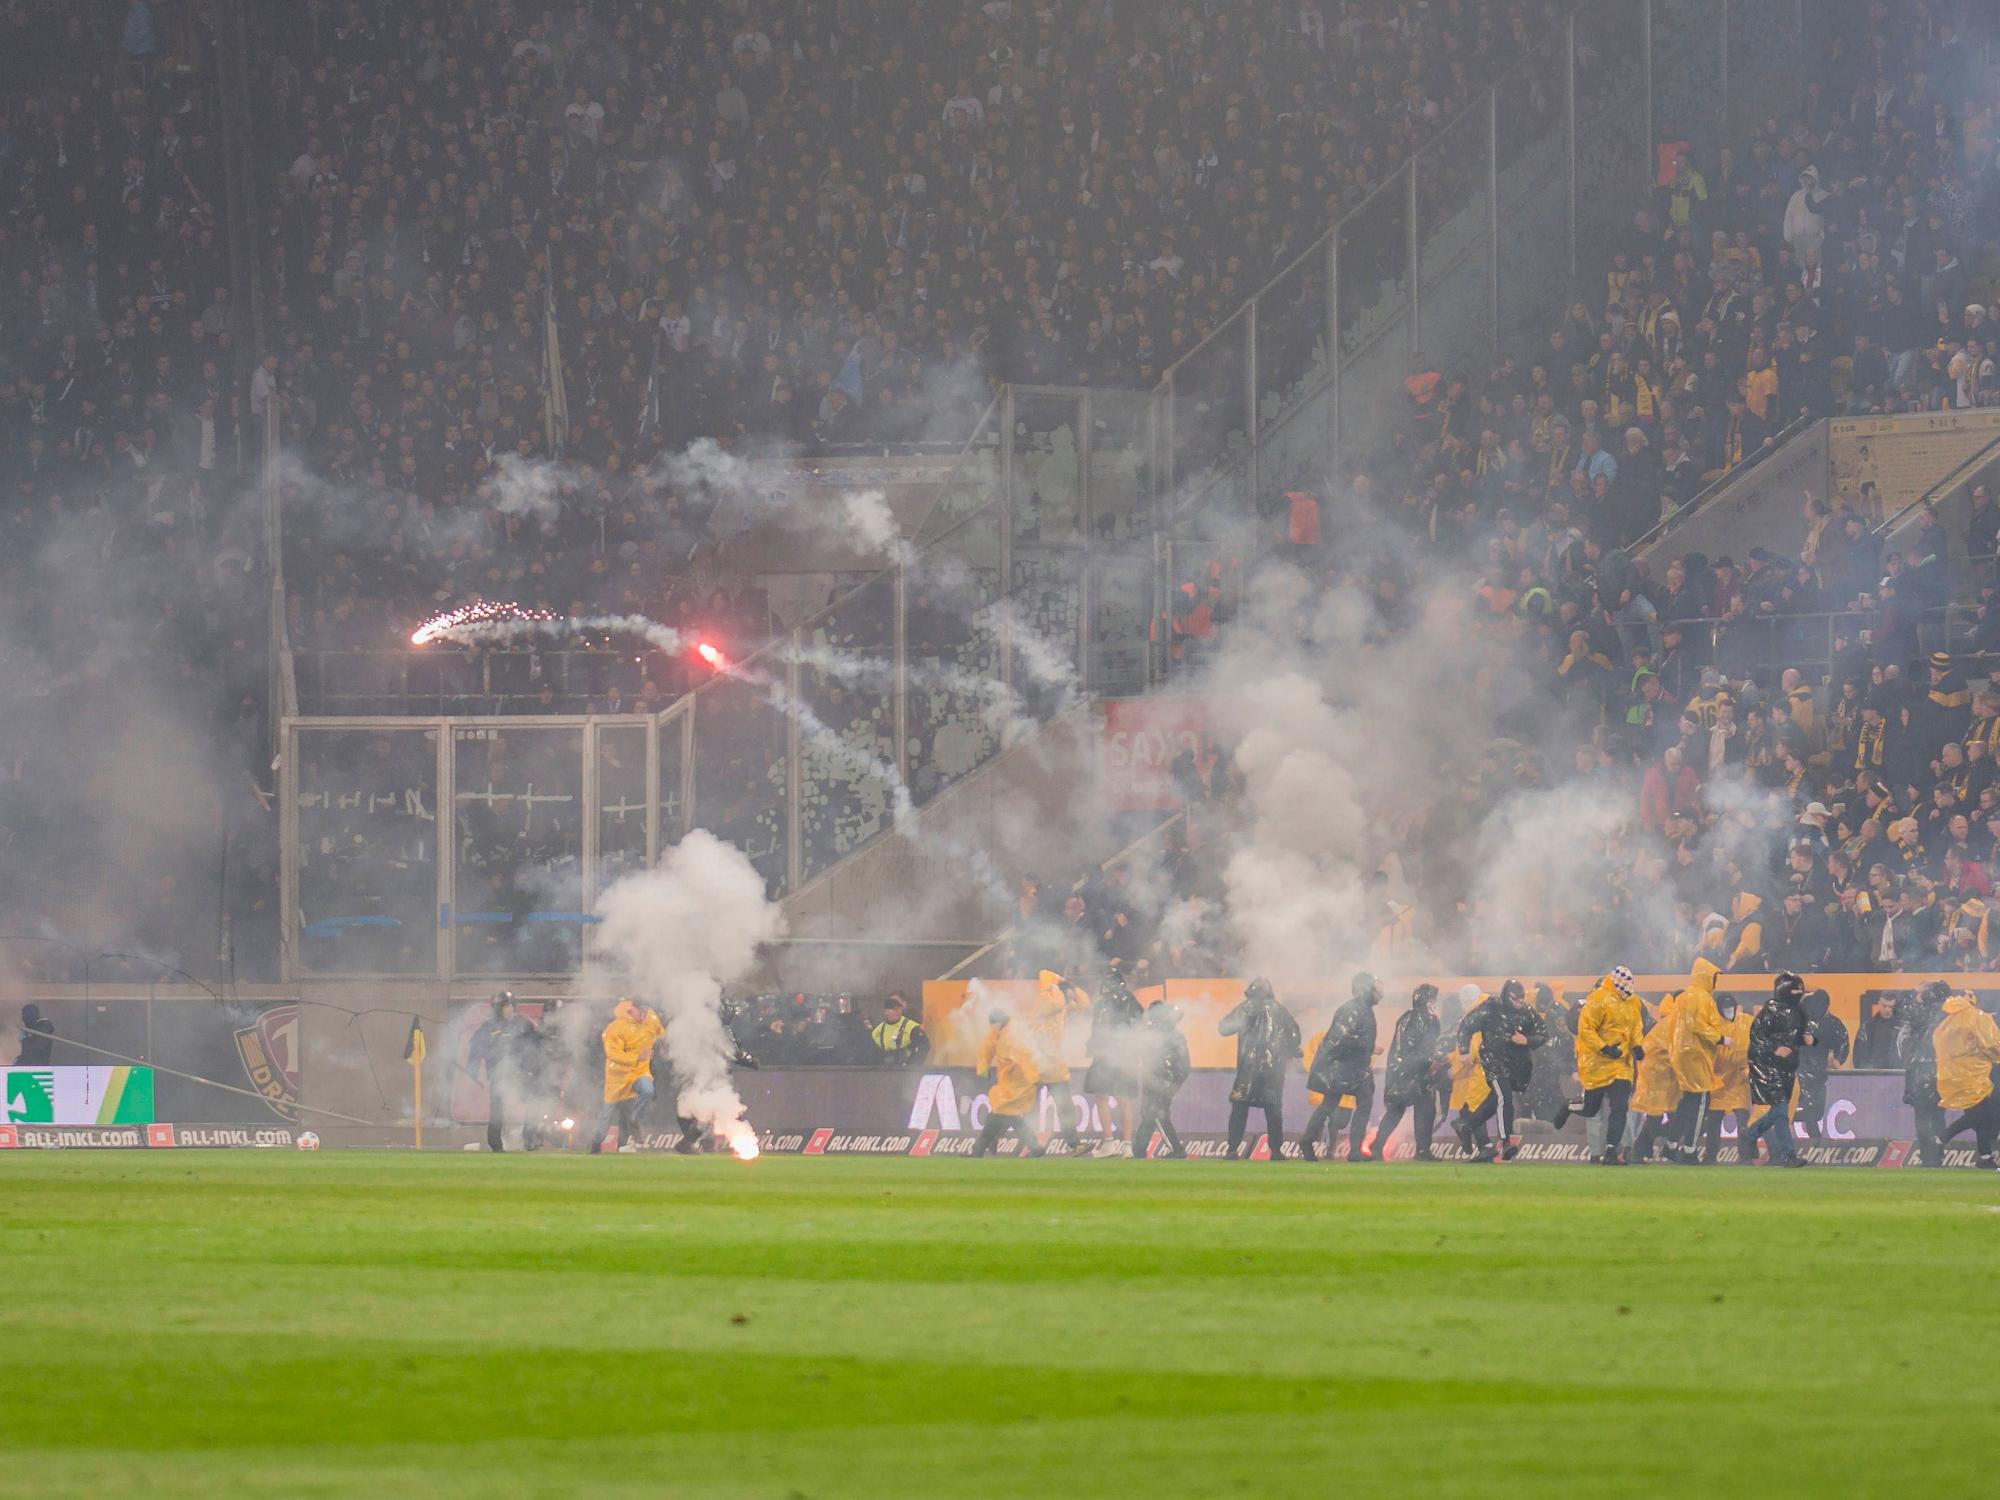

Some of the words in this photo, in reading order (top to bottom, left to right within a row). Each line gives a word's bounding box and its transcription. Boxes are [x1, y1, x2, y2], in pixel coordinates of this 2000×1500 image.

[24, 1130, 139, 1147] ALL-INKL.COM
[180, 1129, 293, 1147] ALL-INKL.COM
[827, 1135, 911, 1151] ALL-INKL.COM
